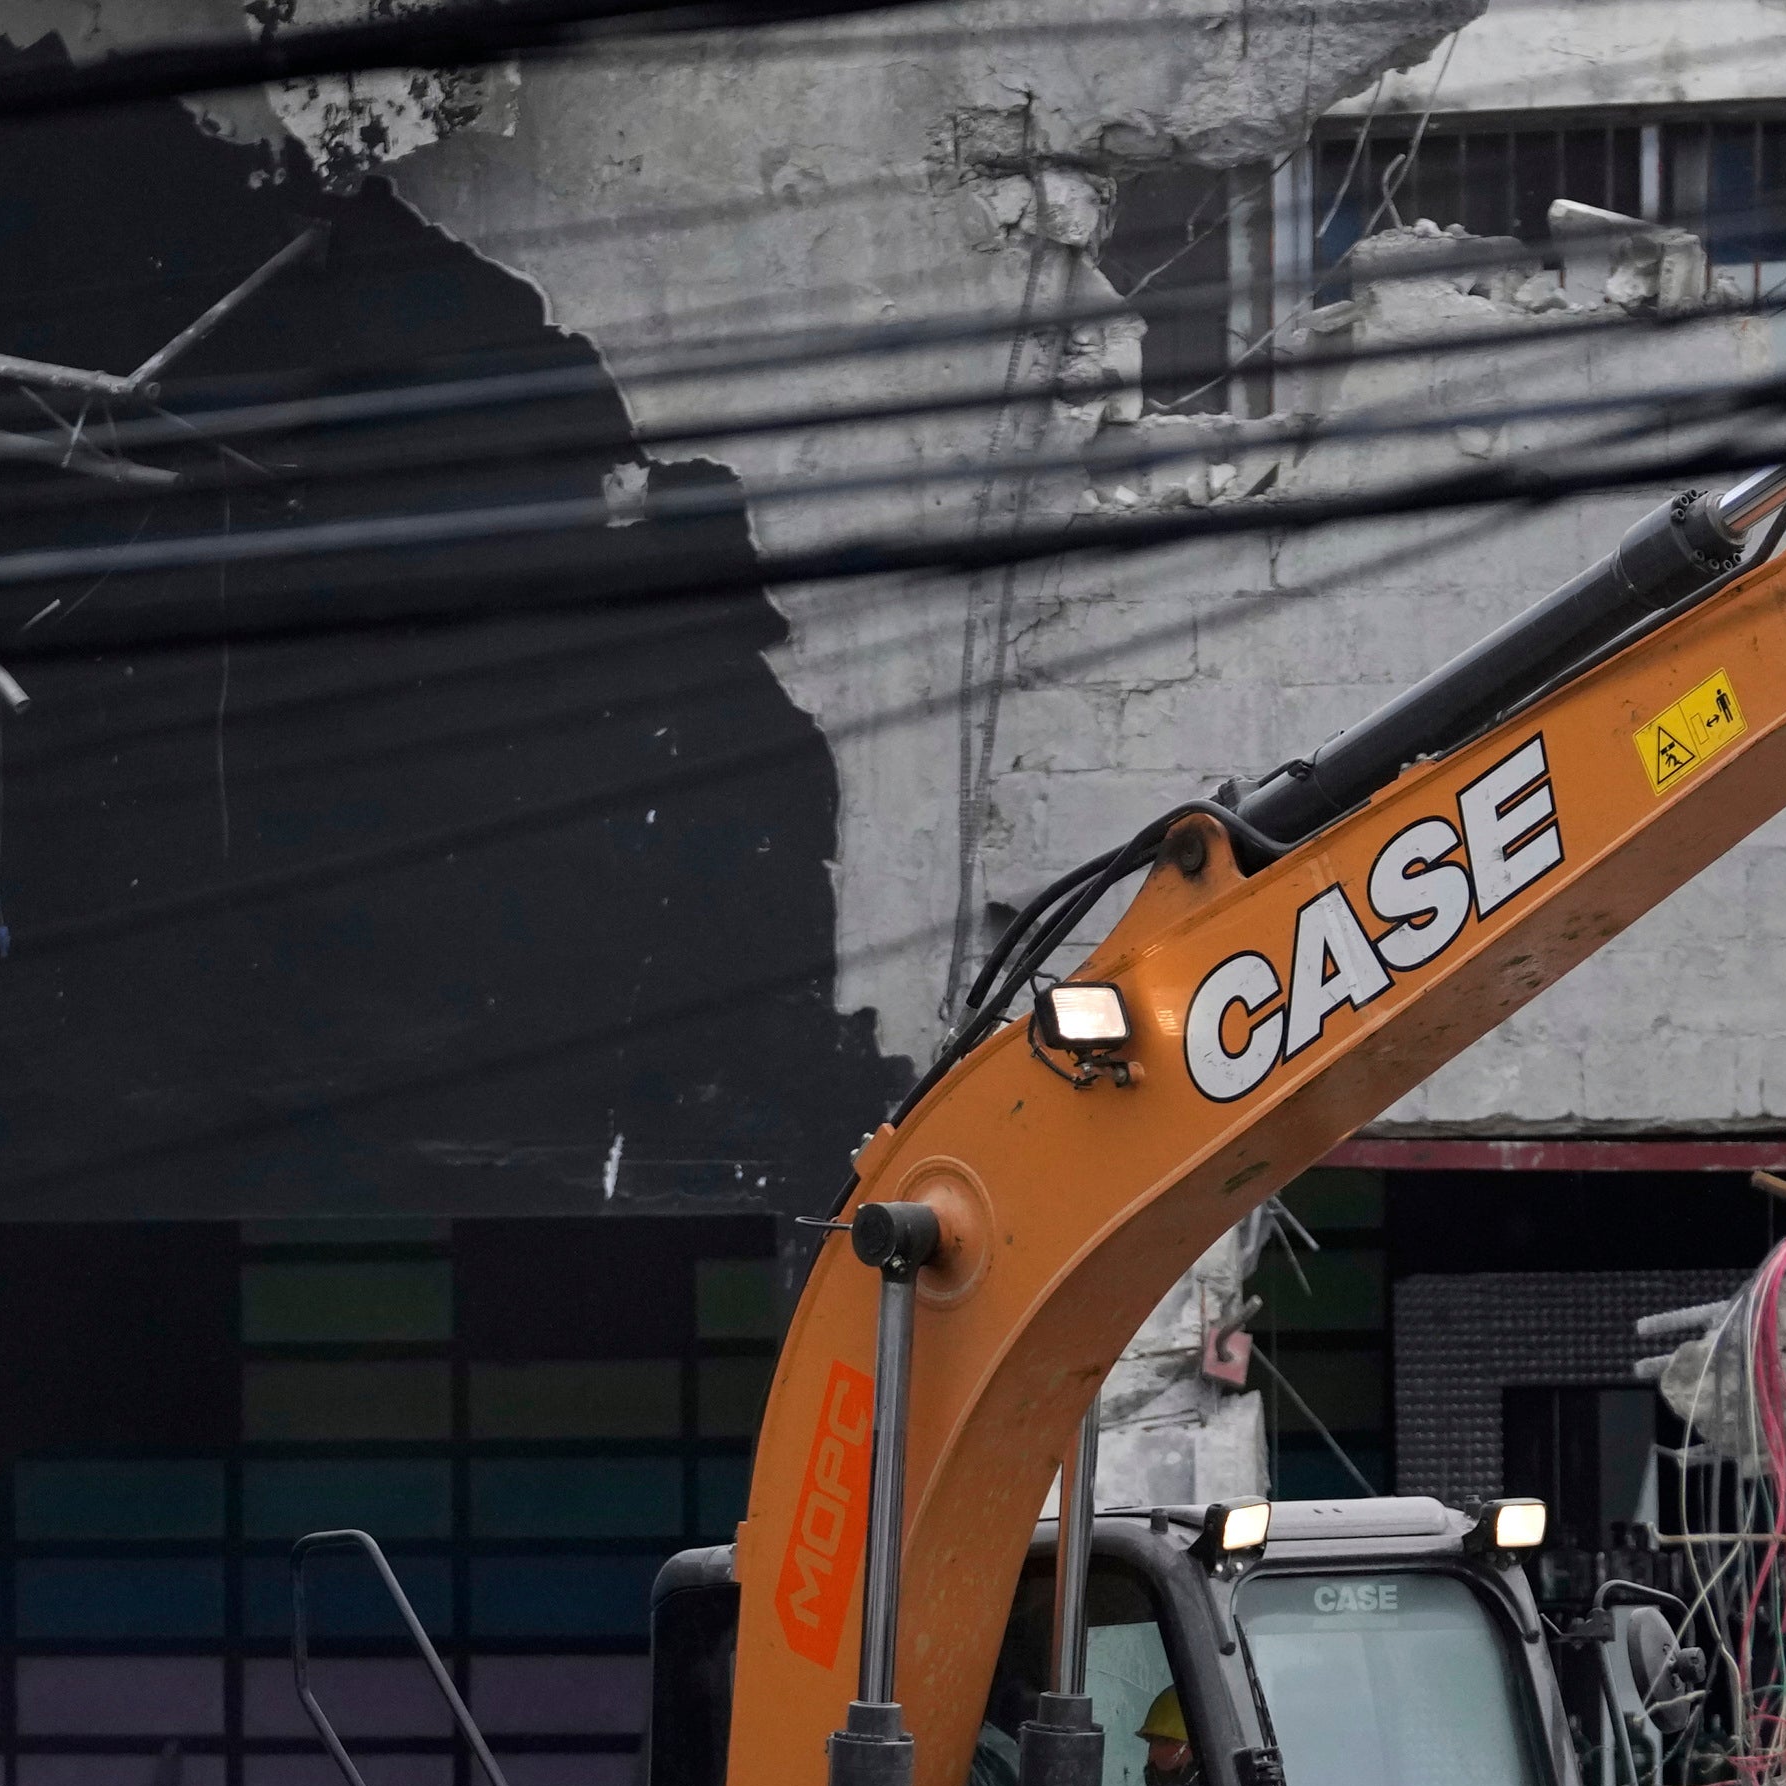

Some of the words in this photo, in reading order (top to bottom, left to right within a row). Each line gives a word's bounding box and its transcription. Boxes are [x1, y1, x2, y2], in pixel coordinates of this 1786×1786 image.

[1185, 732, 1564, 1102] CASE
[789, 1380, 867, 1630] MOPC
[1314, 1584, 1398, 1612] CASE
